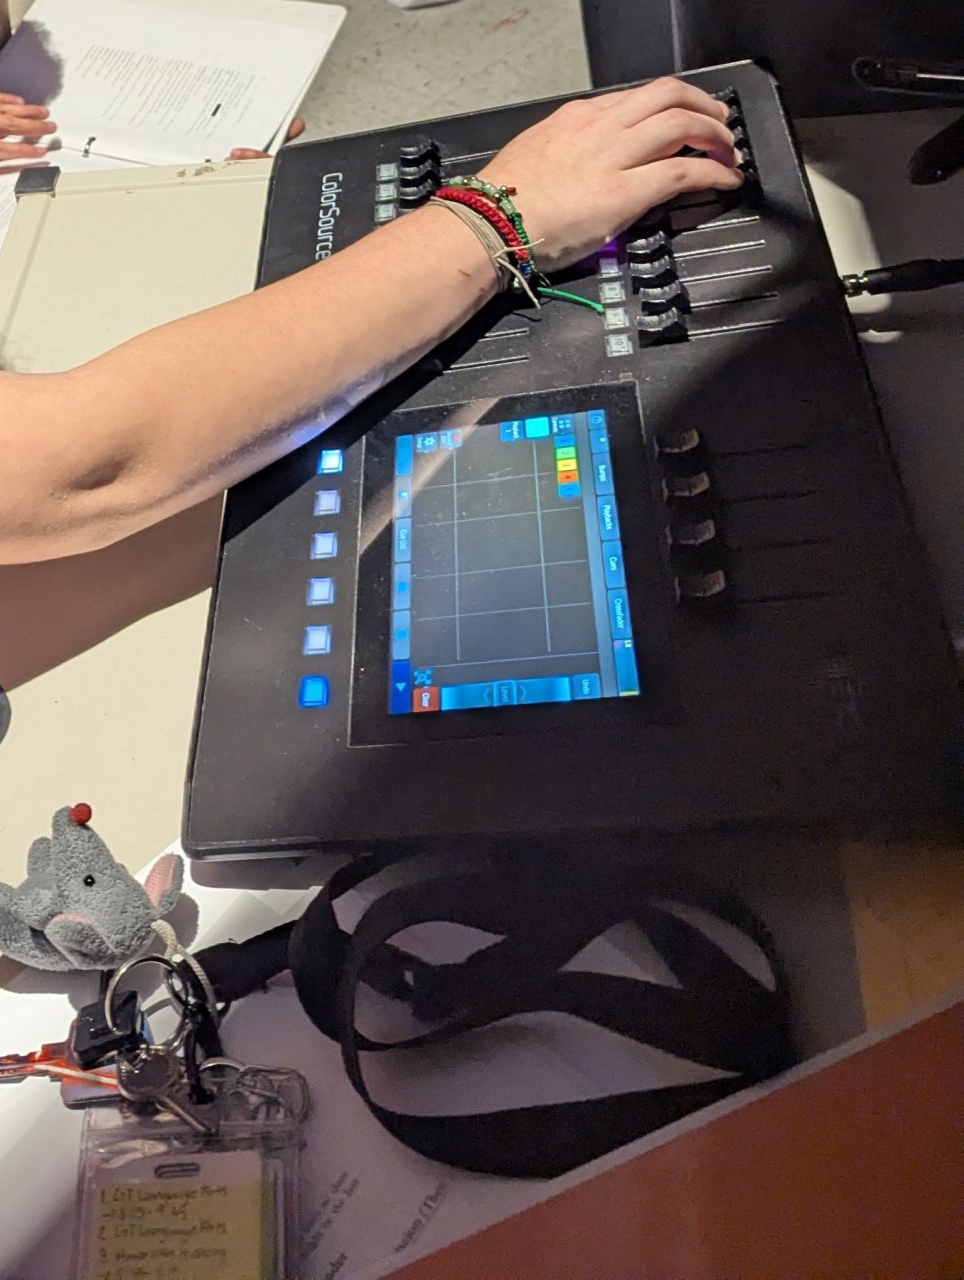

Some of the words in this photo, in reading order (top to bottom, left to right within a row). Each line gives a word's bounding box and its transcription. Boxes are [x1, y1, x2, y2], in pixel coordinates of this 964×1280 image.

[315, 172, 343, 260] ColorSource
[602, 504, 614, 530] Playbacks
[608, 556, 619, 571] Cues
[613, 598, 627, 630] Crossfader
[500, 685, 510, 703] Level
[580, 678, 591, 695] Undo
